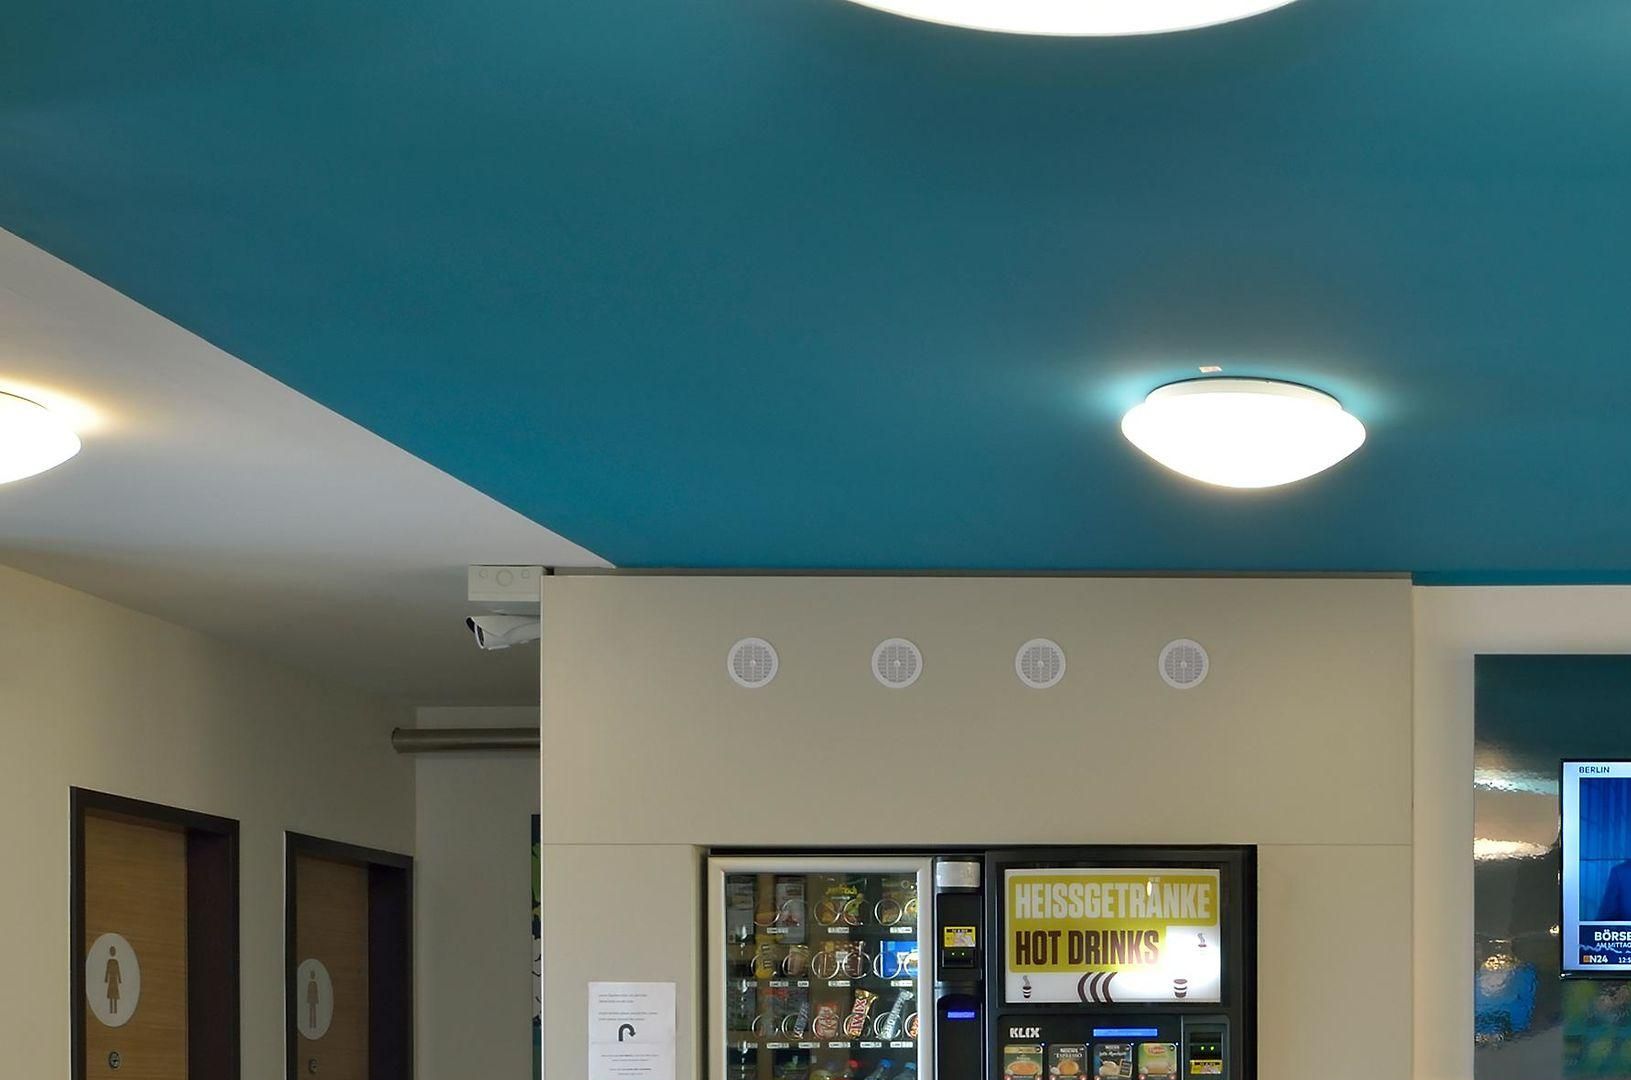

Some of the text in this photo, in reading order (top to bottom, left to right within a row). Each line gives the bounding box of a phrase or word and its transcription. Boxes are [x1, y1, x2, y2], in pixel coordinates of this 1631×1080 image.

[1579, 766, 1610, 774] BERLIN
[1015, 877, 1211, 919] HEISSGETRÄNKE
[1016, 930, 1159, 966] HOT DRINKS
[1589, 955, 1608, 963] N24
[850, 998, 867, 1031] TWIX
[1009, 1027, 1040, 1038] KLIX
